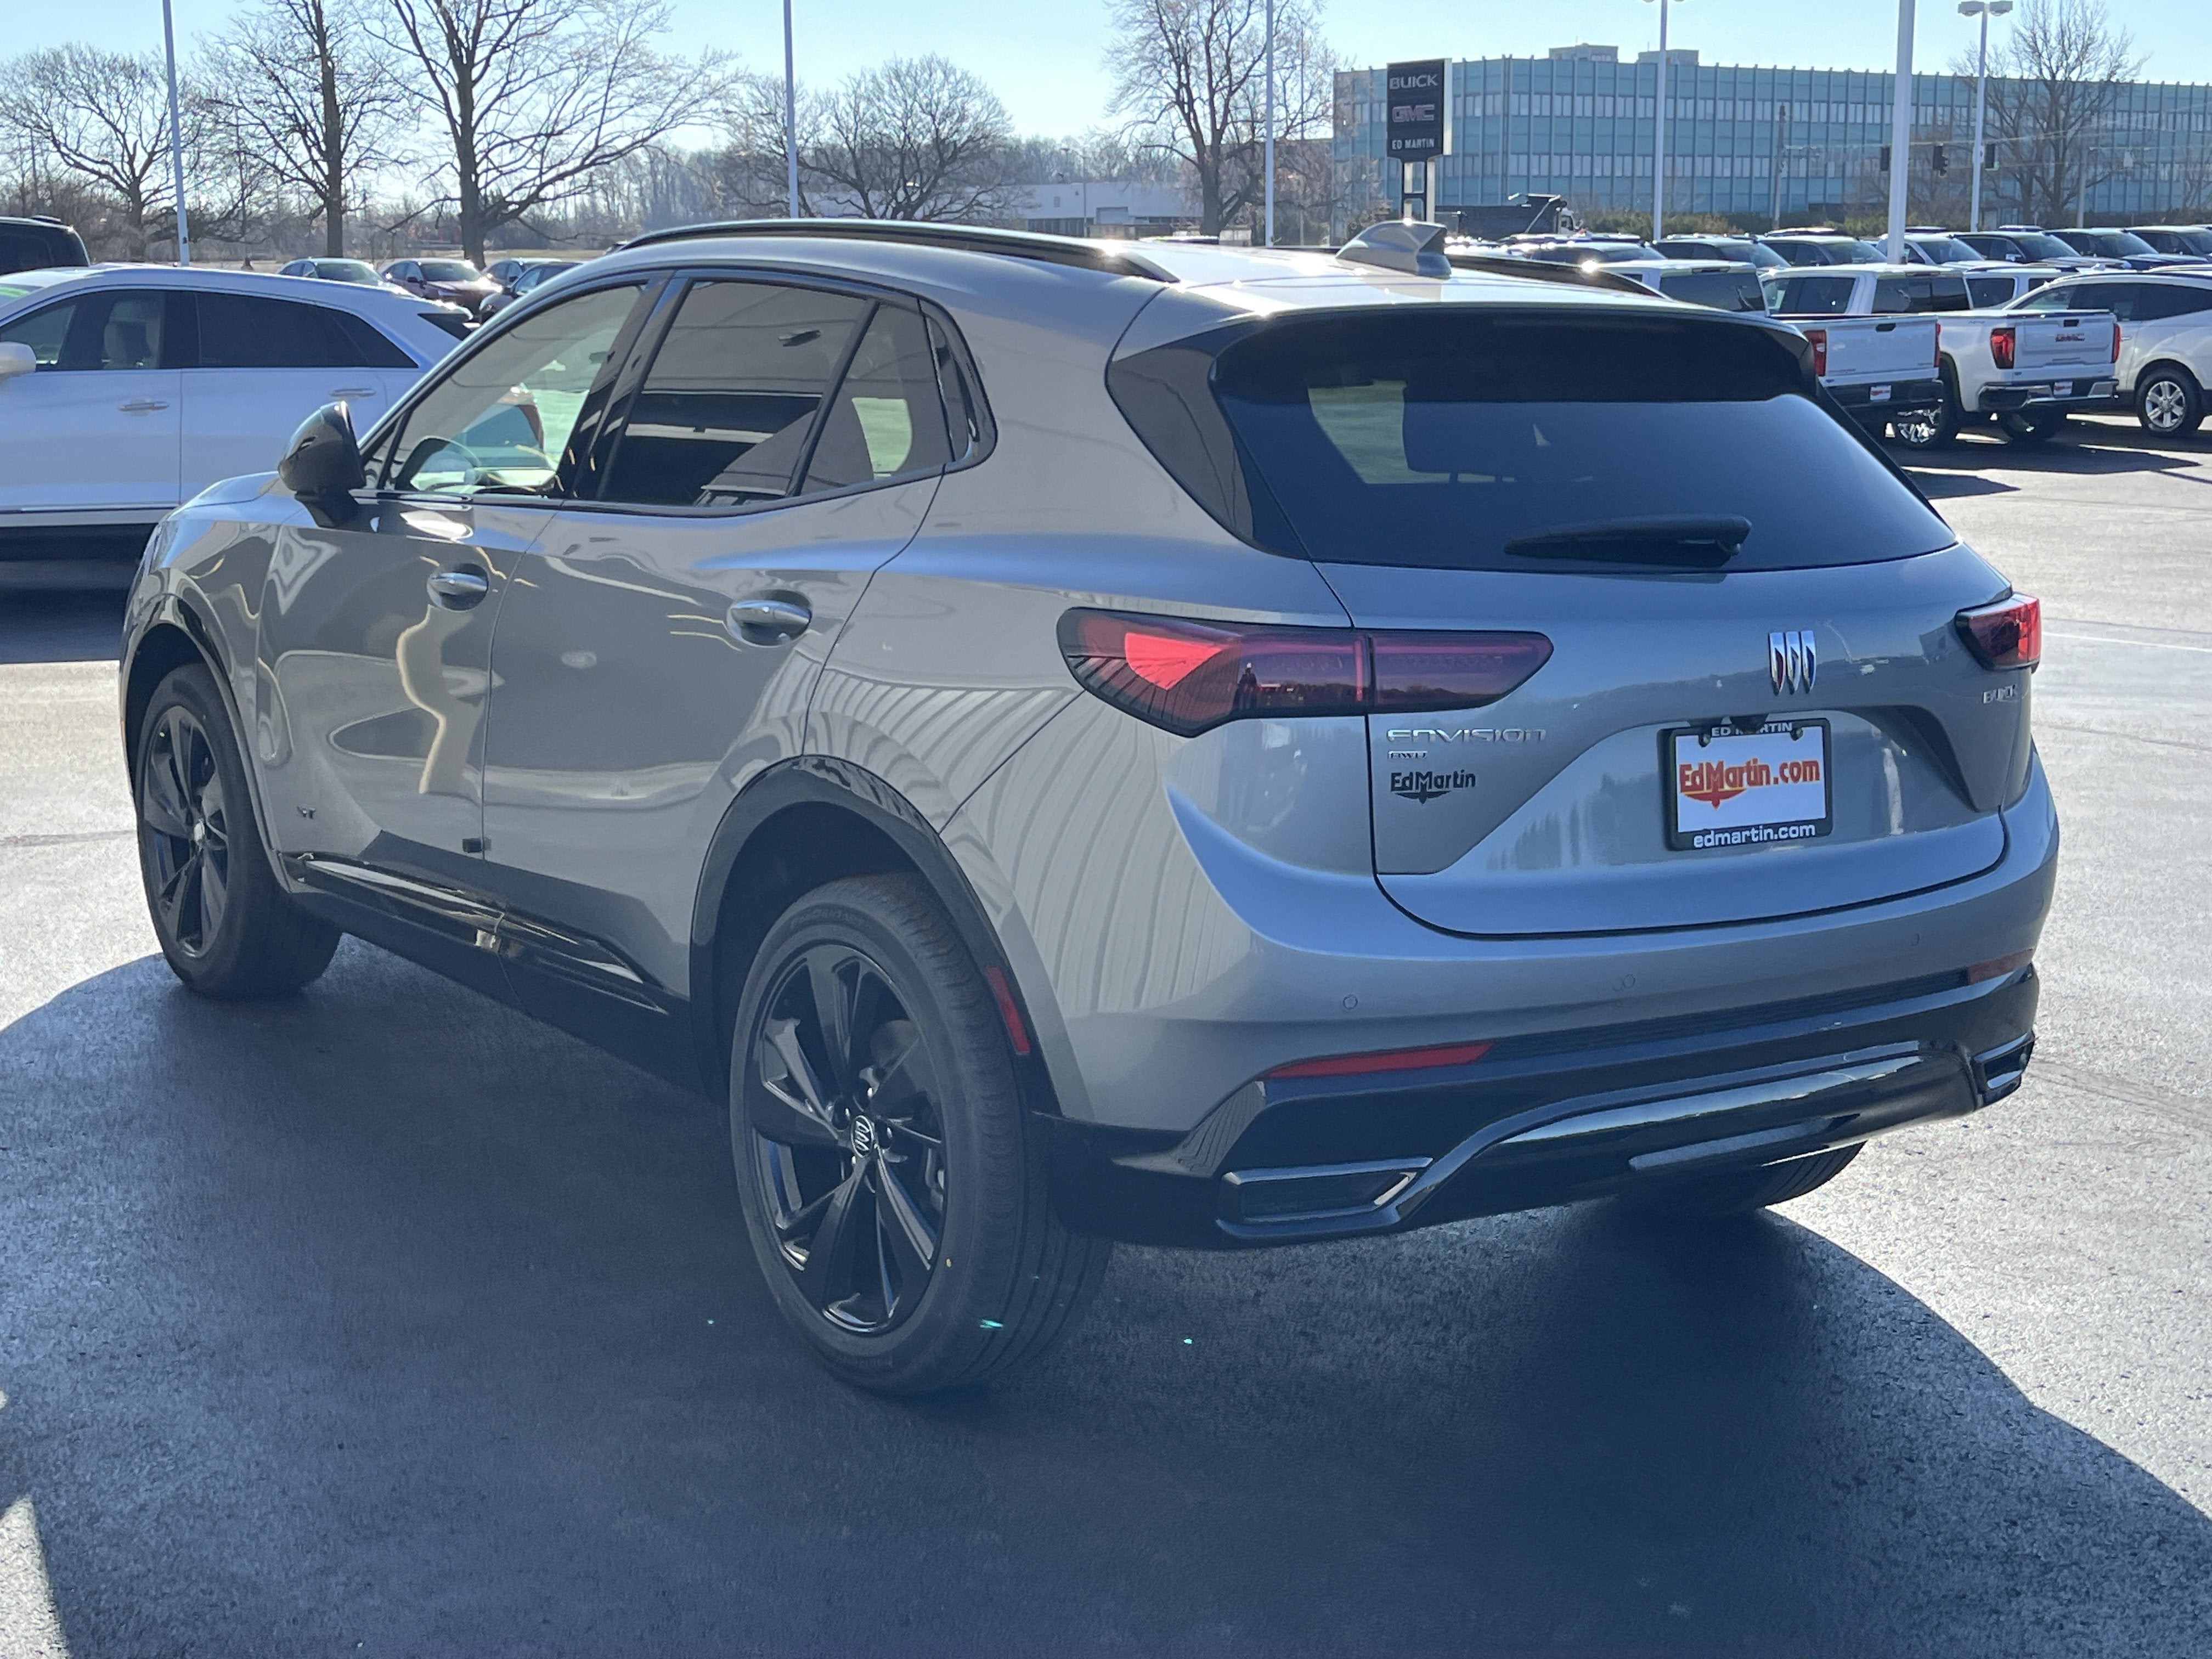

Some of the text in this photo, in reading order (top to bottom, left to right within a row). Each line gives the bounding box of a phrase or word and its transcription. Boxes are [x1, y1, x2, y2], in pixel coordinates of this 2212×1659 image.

[1390, 74, 1438, 89] BUICK
[1392, 104, 1435, 122] GMC
[1392, 138, 1435, 150] ED MARTIN
[1386, 729, 1546, 743] ENVISION
[1712, 727, 1731, 736] ED
[1391, 770, 1476, 792] EdMartin
[1694, 824, 1816, 849] edmartin.com
